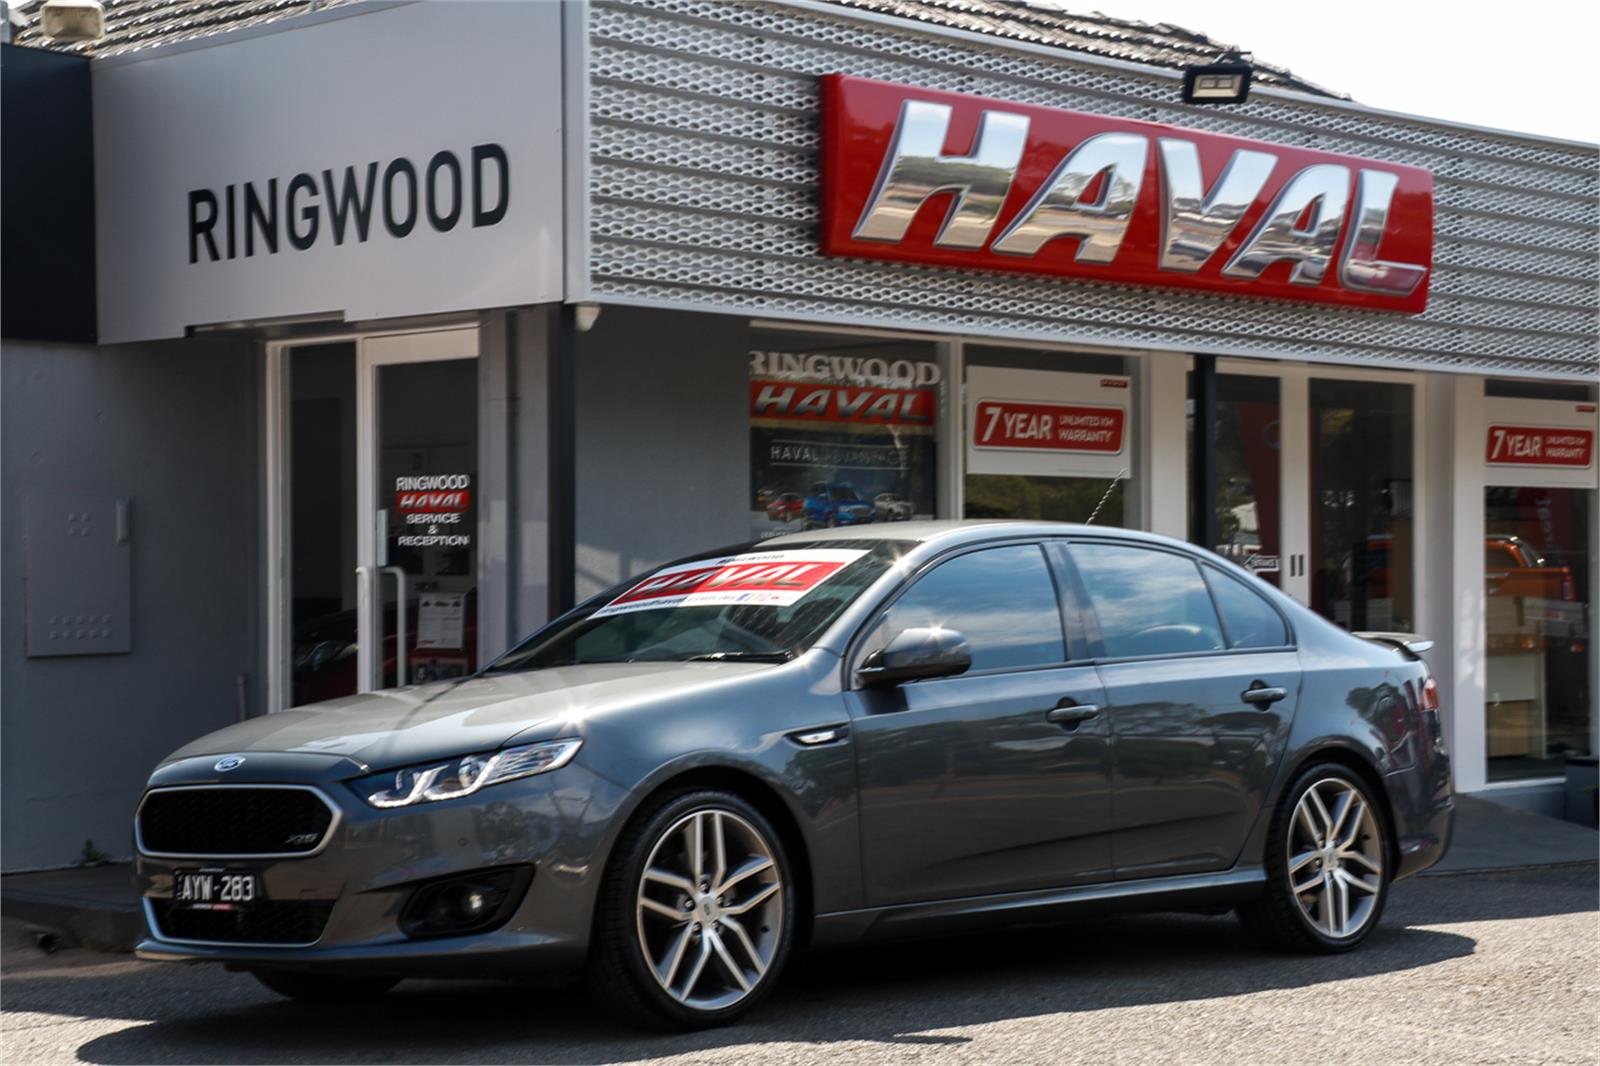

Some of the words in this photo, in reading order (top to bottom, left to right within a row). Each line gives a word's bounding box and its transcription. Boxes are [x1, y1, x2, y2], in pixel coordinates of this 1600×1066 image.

[187, 143, 510, 264] RINGWOOD
[852, 99, 1428, 295] HAVAL
[750, 351, 941, 386] RINGWOOD
[754, 385, 929, 422] HAVAL
[982, 407, 1002, 442] 7
[1003, 413, 1053, 440] YEAR
[1059, 429, 1114, 443] WARRANTY
[1491, 429, 1506, 459] 7
[1506, 434, 1543, 457] YEAR
[770, 446, 819, 462] HAVAL
[396, 474, 469, 491] RINGWOOD
[400, 493, 464, 509] HAVAL
[406, 512, 462, 524] SERVICE
[428, 524, 438, 534] &
[398, 535, 469, 547] RECEPTION
